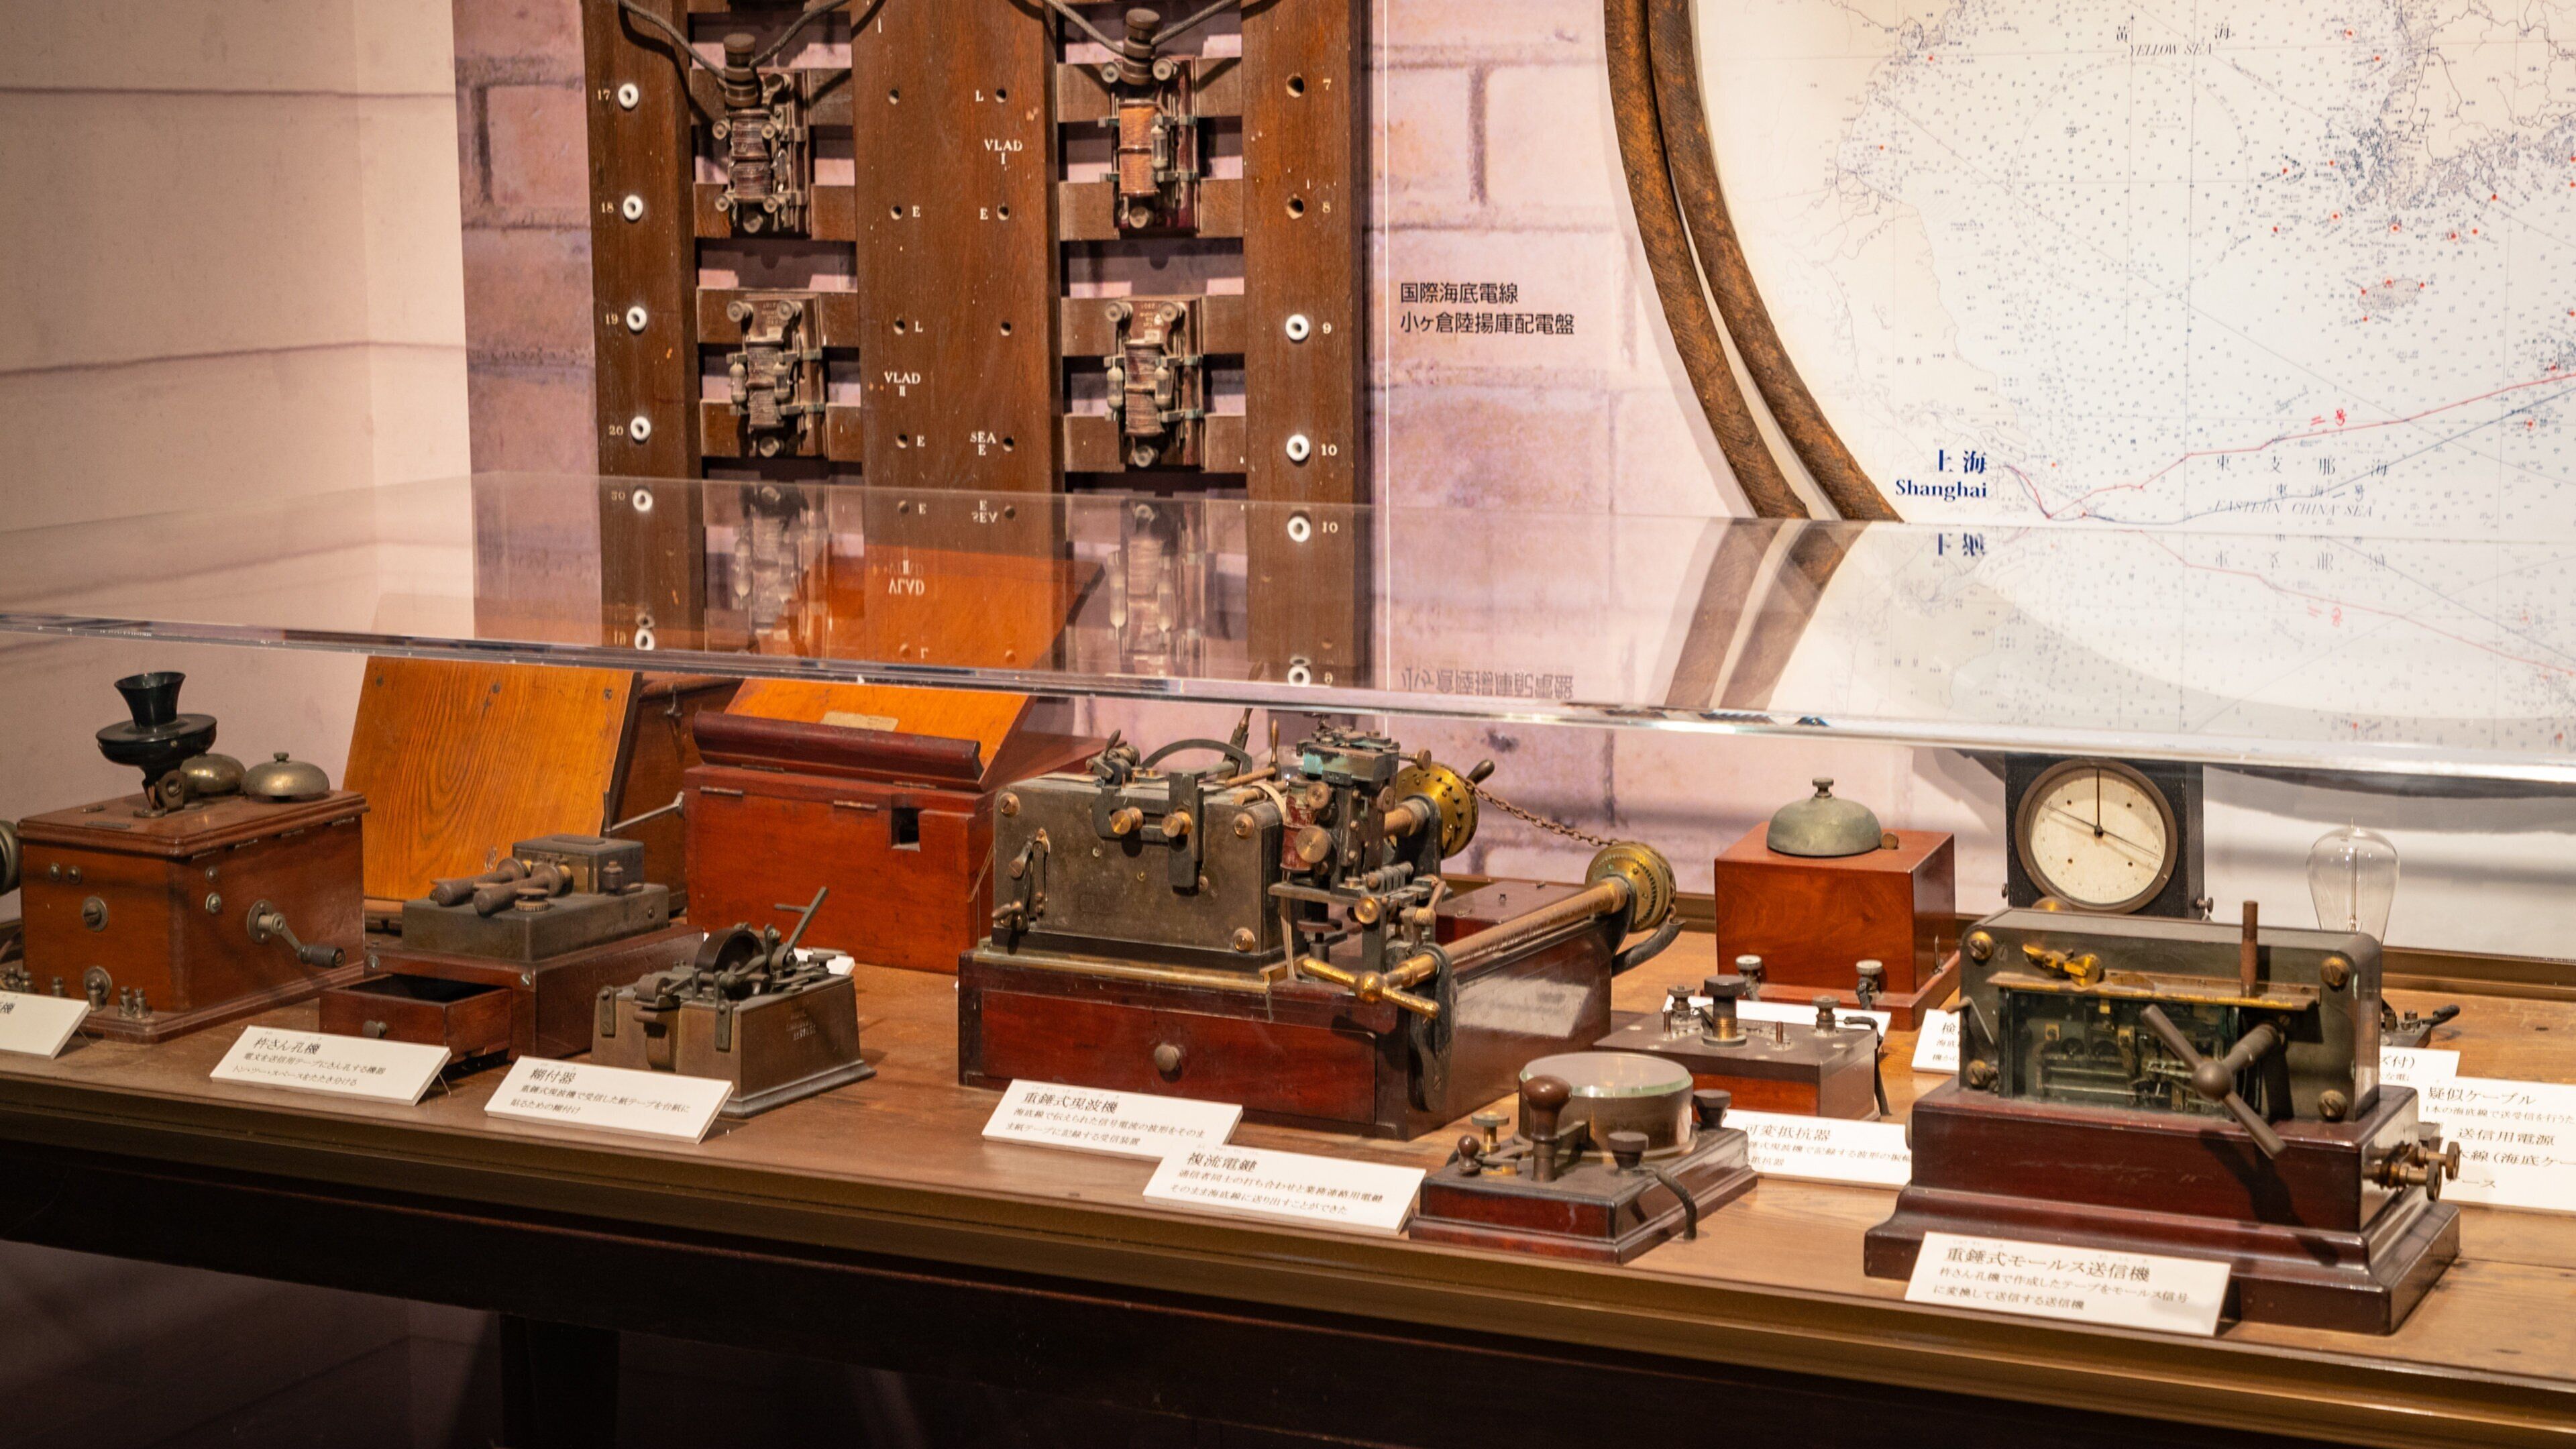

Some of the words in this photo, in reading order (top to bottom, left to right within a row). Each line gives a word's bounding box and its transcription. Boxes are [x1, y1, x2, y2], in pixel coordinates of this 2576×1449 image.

[1322, 78, 1332, 91] 7
[597, 89, 610, 101] 17
[975, 89, 984, 102] L
[984, 139, 1023, 152] VLAD
[601, 202, 614, 213] 18
[912, 205, 920, 217] E
[979, 207, 989, 220] E
[1322, 201, 1331, 213] 8
[1400, 282, 1519, 304] 国際海底電線
[605, 313, 619, 325] 19
[1400, 311, 1575, 335] 小ヶ倉陸揚庫配電盤
[914, 321, 923, 333] L
[1322, 322, 1332, 334] 9
[884, 371, 921, 385] VLAD
[608, 425, 624, 436] 20
[970, 431, 997, 443] SEA
[916, 435, 925, 447] E
[978, 445, 986, 455] E
[1321, 443, 1338, 456] 10
[1938, 449, 1986, 474] 上海
[1895, 478, 1987, 501] Shanghai
[2427, 1085, 2536, 1106] 疑似ケーブル
[2457, 1128, 2556, 1146] 送信用電源
[1945, 1246, 2151, 1282] 重錘式モールス送信機
